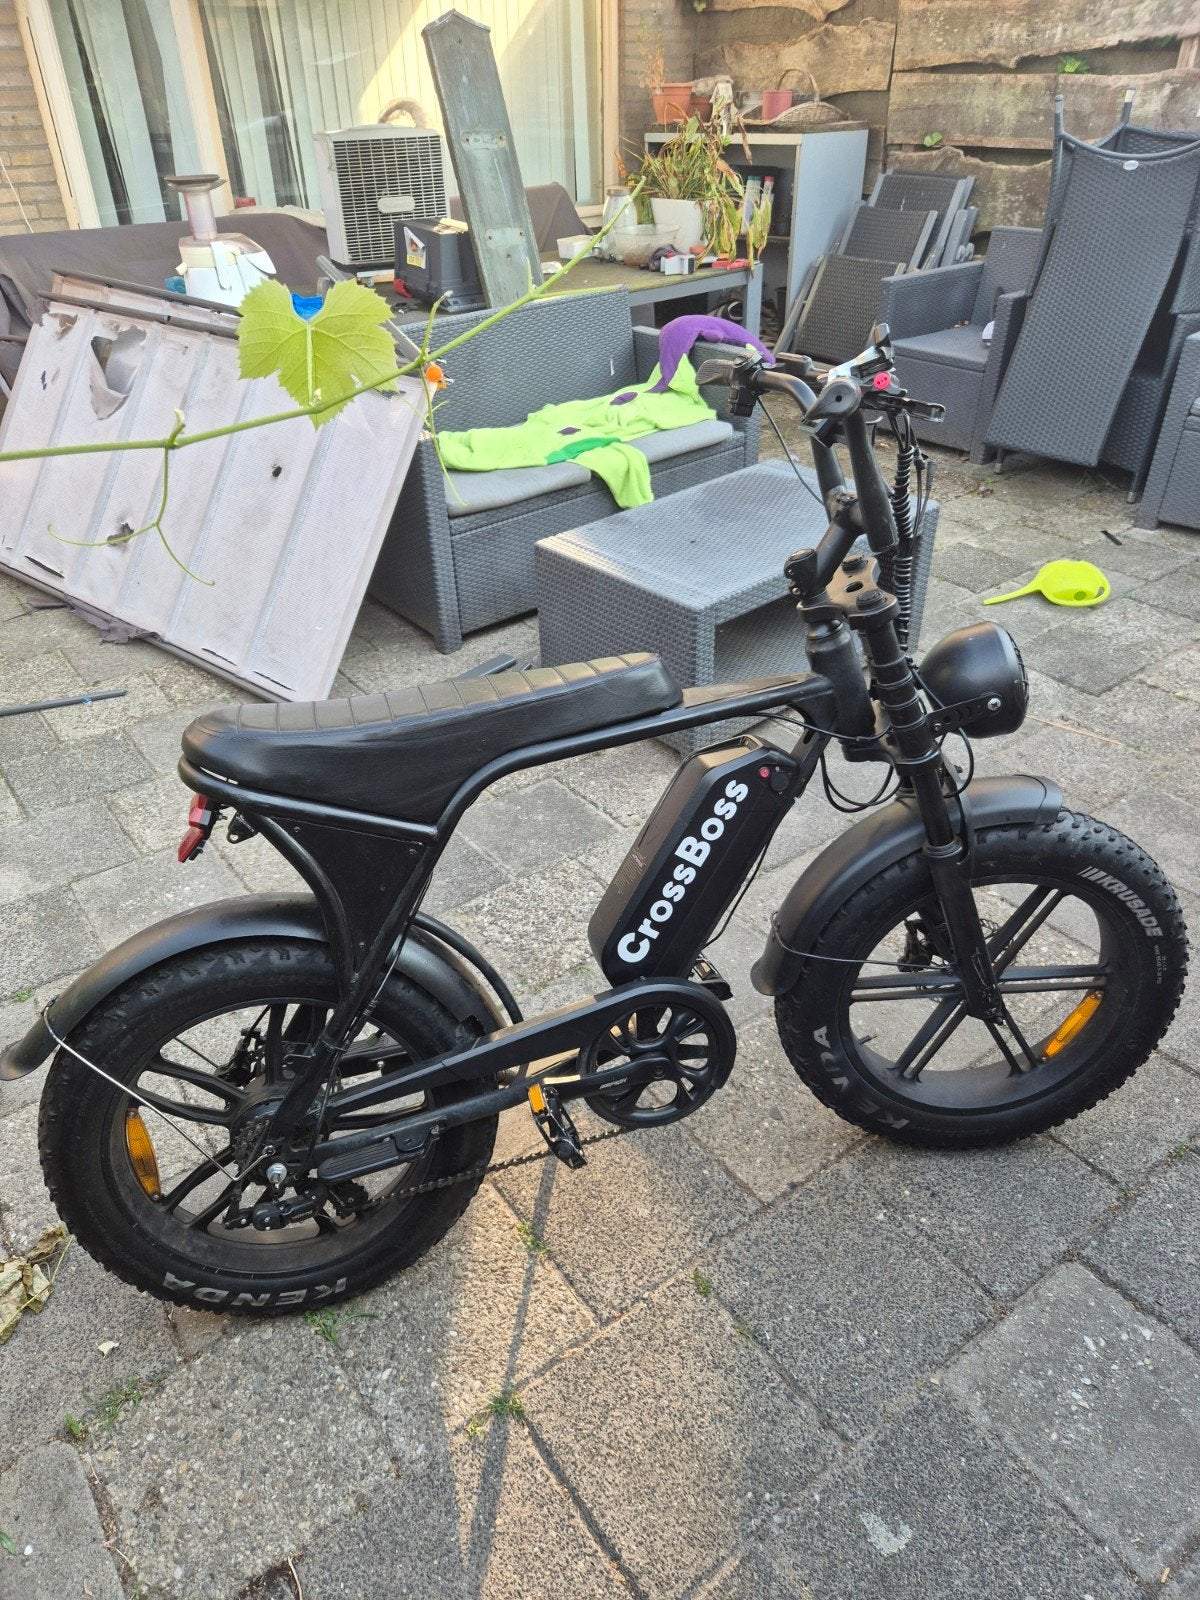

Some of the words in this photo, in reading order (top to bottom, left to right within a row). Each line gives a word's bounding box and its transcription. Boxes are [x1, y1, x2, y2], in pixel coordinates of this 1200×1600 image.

[617, 779, 749, 963] CrossBoss
[1095, 874, 1164, 937] KRUSADE
[162, 1271, 347, 1307] KENDA
